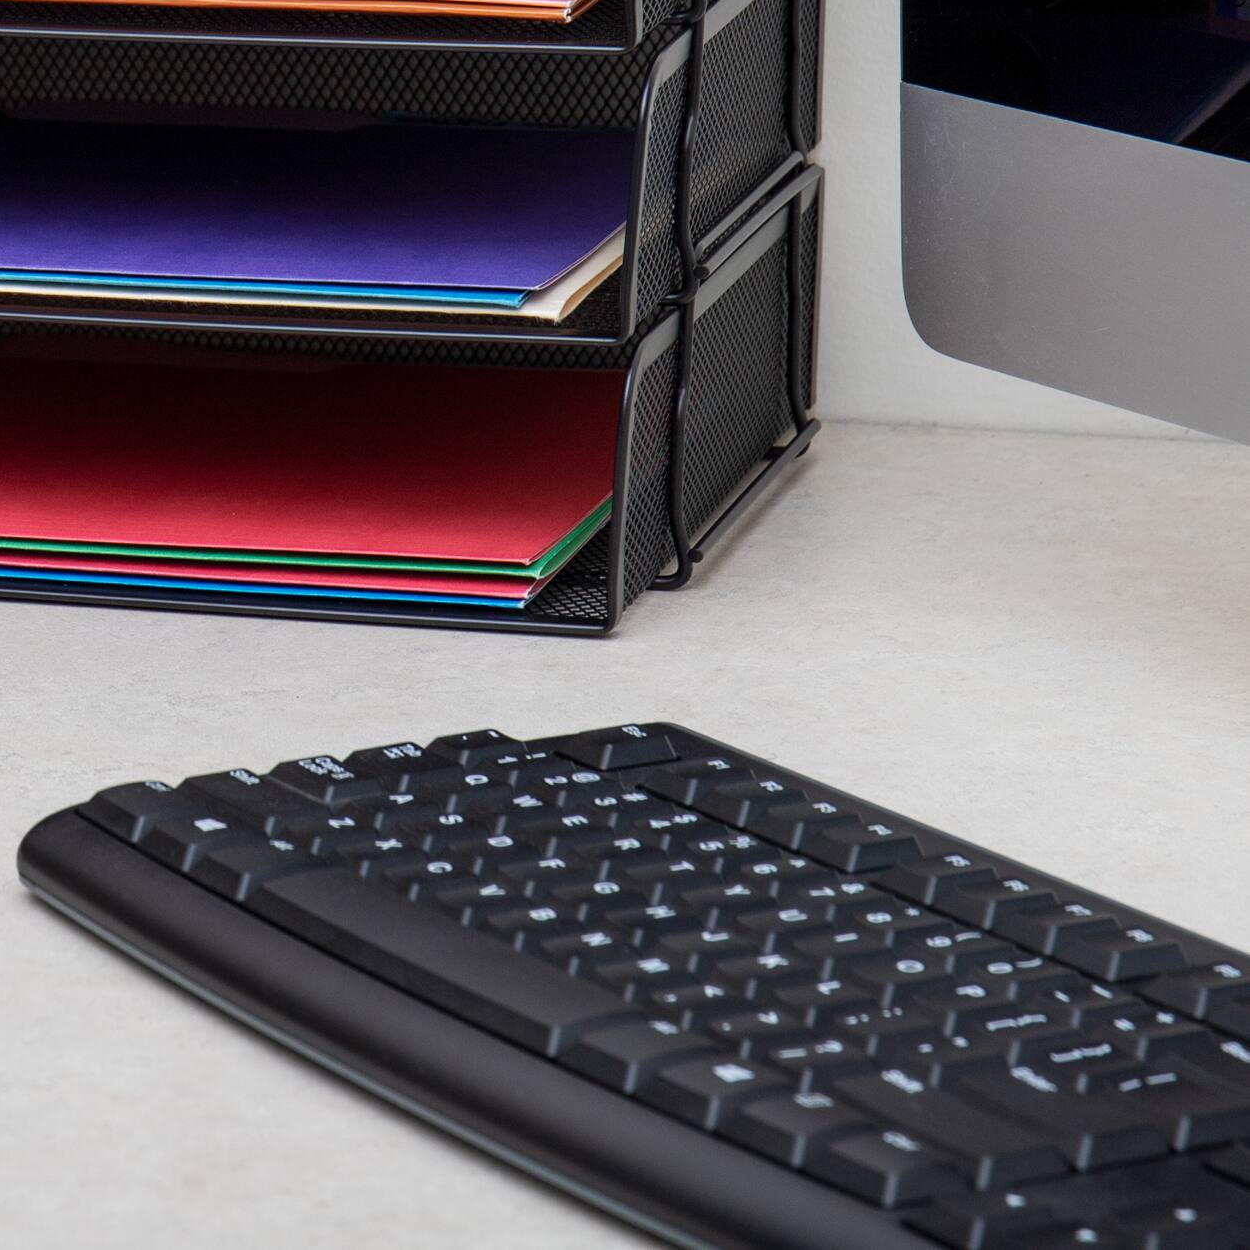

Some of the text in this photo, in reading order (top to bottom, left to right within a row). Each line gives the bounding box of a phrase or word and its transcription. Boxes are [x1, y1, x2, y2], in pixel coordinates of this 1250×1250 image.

[464, 774, 489, 786] Q
[544, 775, 568, 786] 2
[389, 794, 414, 805] A
[513, 794, 542, 808] W
[594, 796, 618, 807] 3
[328, 816, 355, 829] Z
[439, 814, 463, 825] S
[561, 815, 589, 827] E
[375, 838, 402, 851] X
[487, 835, 514, 848] D
[614, 838, 641, 851] R
[699, 840, 725, 851] 5
[427, 861, 453, 873] C
[538, 858, 566, 869] F
[670, 860, 695, 872] T
[753, 863, 778, 875] 6
[479, 883, 506, 896] V
[593, 881, 620, 894] G
[724, 884, 751, 896] Y
[529, 907, 557, 921] B
[645, 905, 676, 919] H
[778, 908, 808, 922] U
[866, 912, 892, 924] 8
[581, 932, 612, 947] N
[701, 930, 729, 942] J
[926, 936, 952, 948] 9
[955, 985, 986, 998] P
